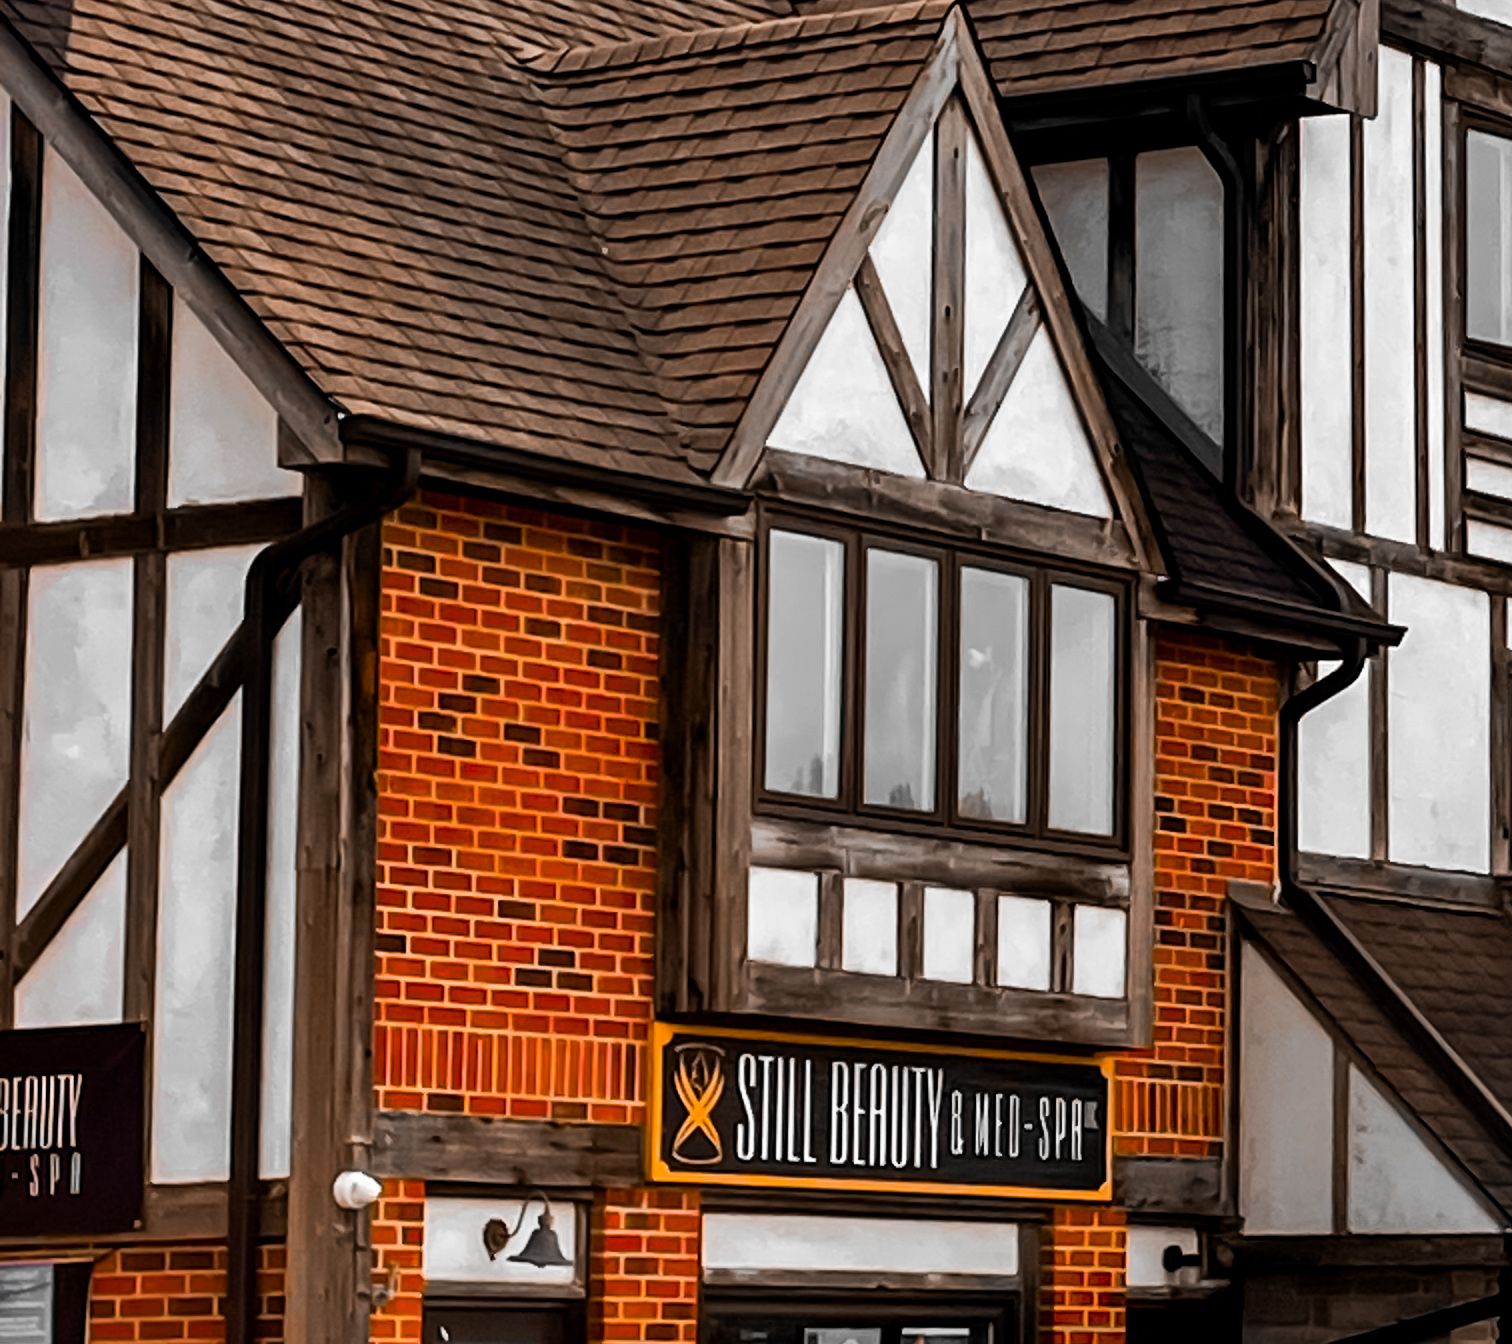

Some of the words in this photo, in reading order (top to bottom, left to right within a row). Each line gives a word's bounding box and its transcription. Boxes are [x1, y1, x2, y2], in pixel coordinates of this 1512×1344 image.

[736, 1053, 817, 1163] STILL
[829, 1060, 944, 1169] BEAUTY
[951, 1089, 964, 1156] &
